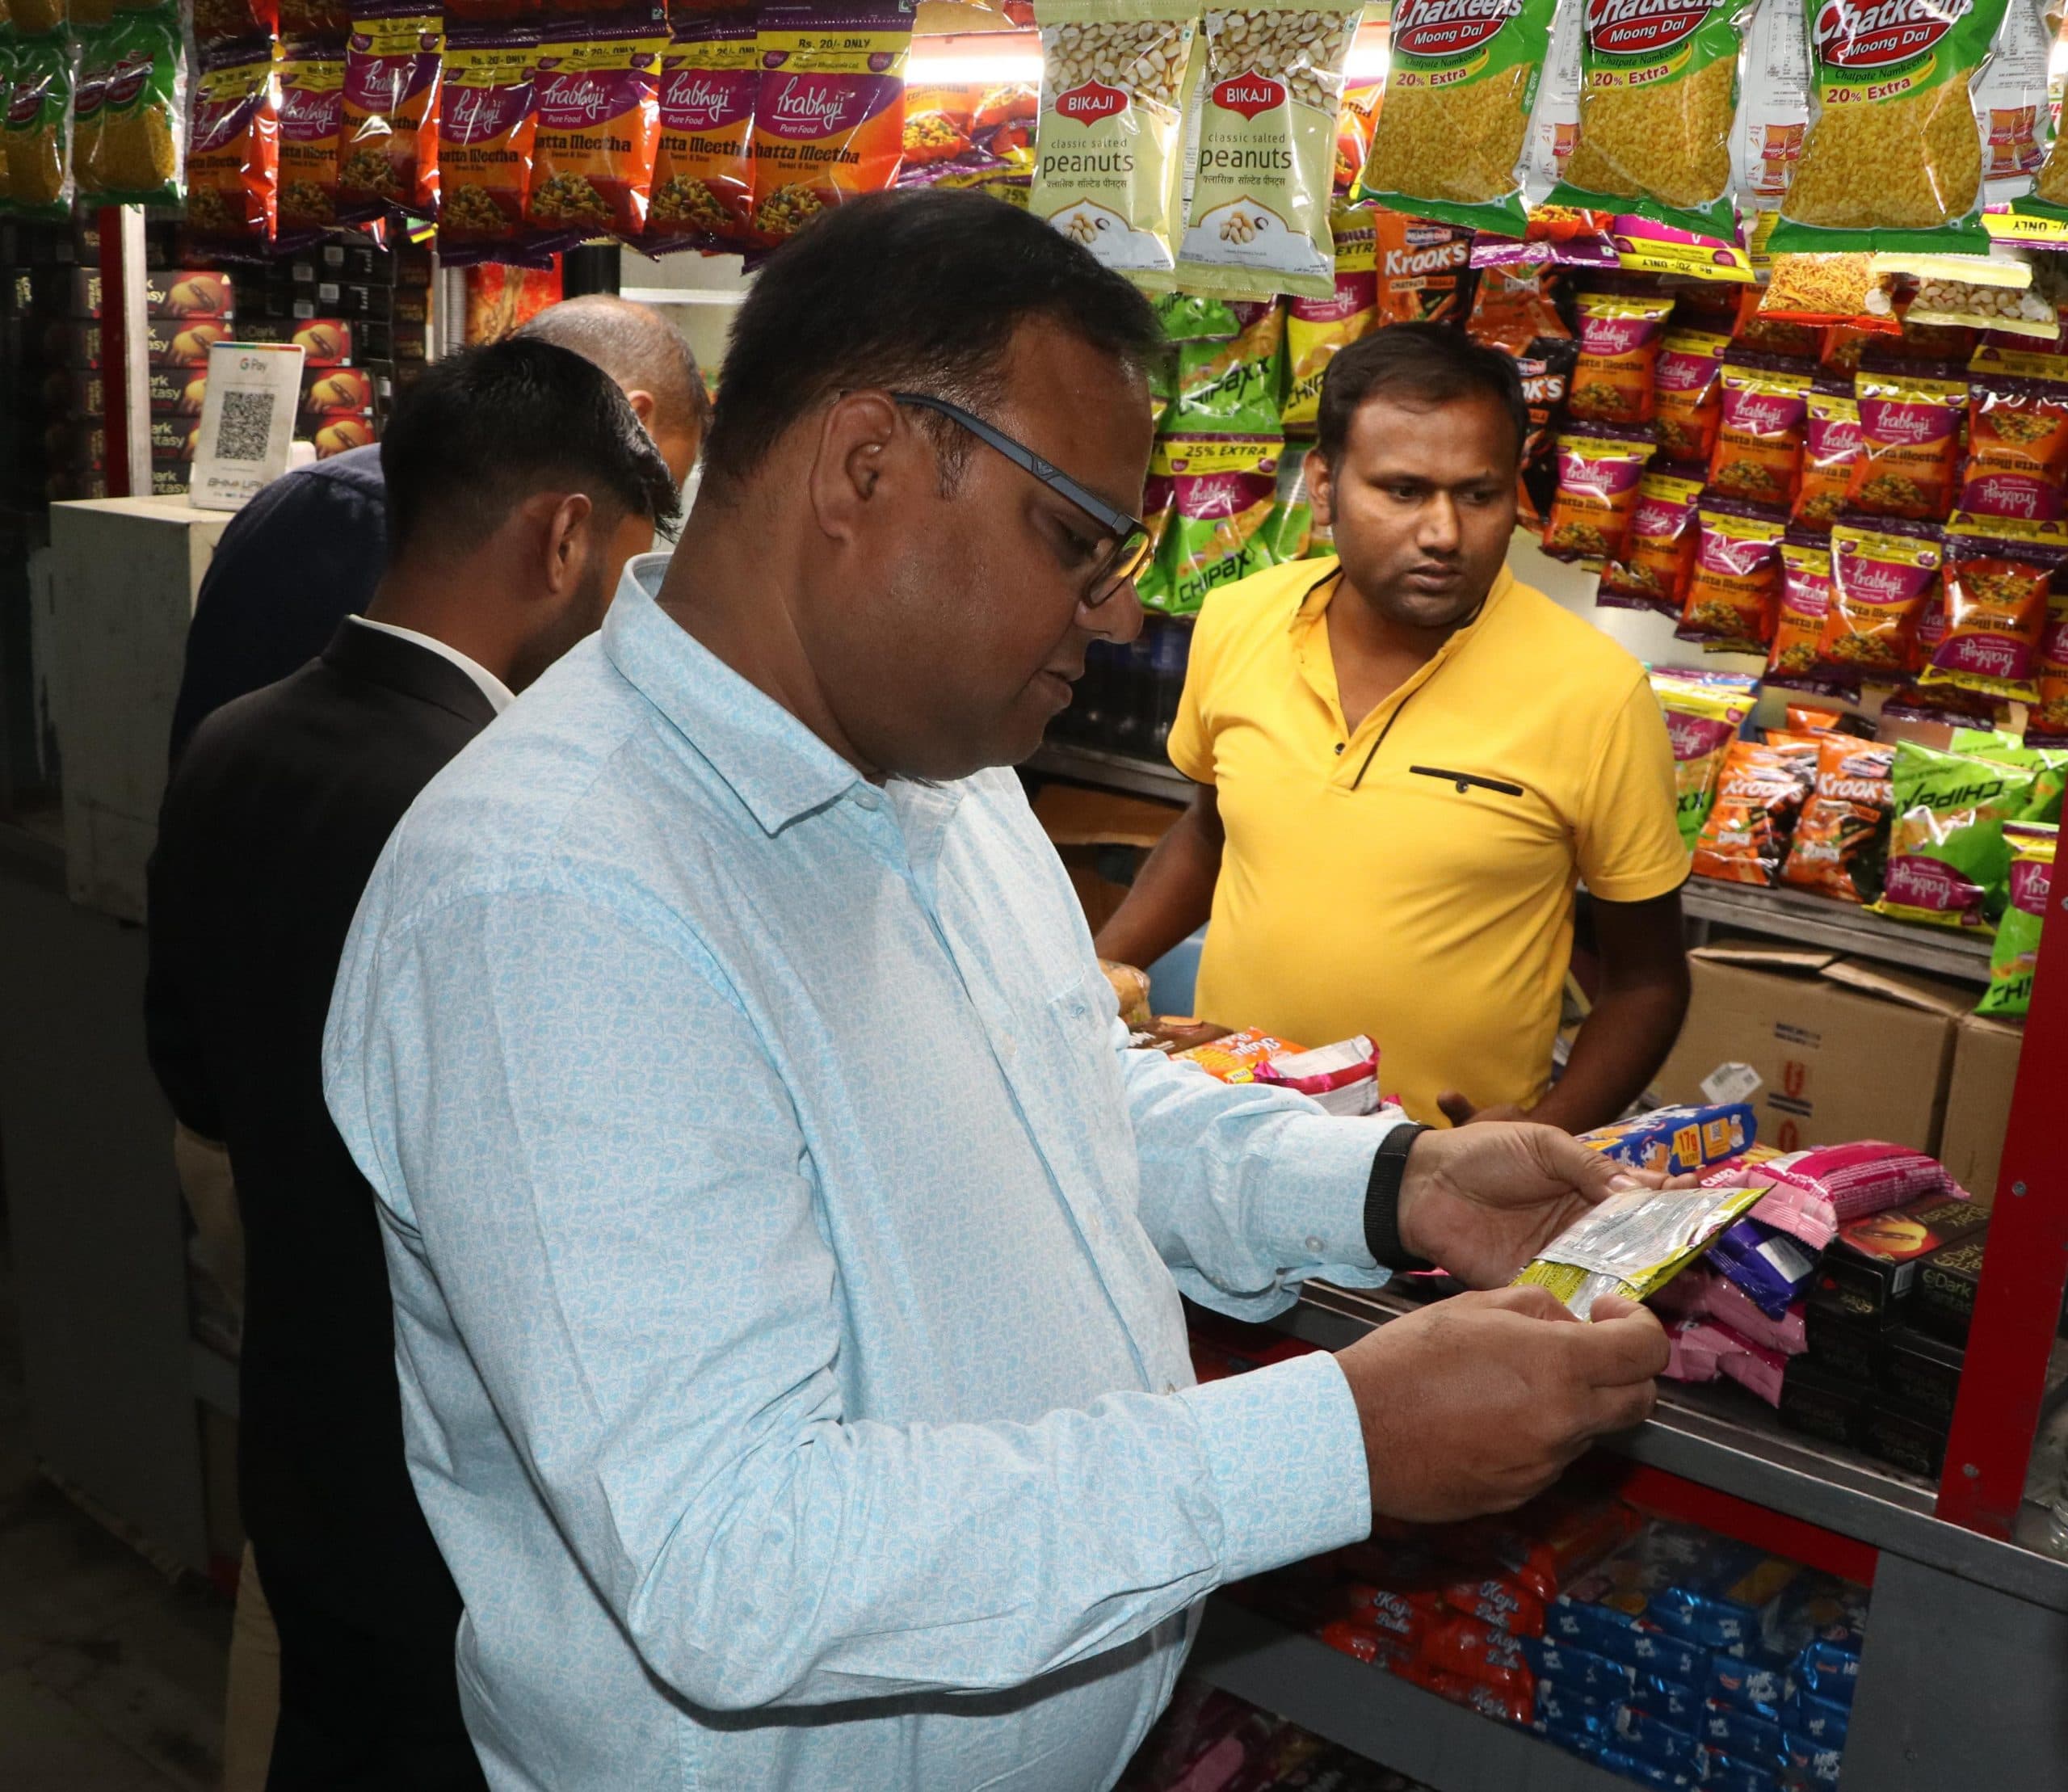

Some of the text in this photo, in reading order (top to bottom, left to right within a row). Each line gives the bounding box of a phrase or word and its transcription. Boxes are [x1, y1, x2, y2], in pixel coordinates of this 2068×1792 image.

[1414, 23, 1484, 45] Moong Dal
[1610, 17, 1686, 43] Moong Dal
[798, 39, 870, 48] Rs. 20/- ONLY
[1846, 27, 1931, 57] Moong Dal
[1396, 69, 1467, 86] 20% Extra
[1593, 65, 1669, 86] 20% Extra
[542, 76, 604, 120] Prabhuji
[664, 72, 730, 122] Prabhuji
[1226, 87, 1271, 103] BIKAJI
[1826, 78, 1911, 103] 20% Extra
[776, 76, 845, 129] Prabhuji
[1068, 95, 1113, 111] BIKAJI
[565, 115, 581, 124] Food
[668, 115, 704, 124] Pure Food
[780, 124, 818, 134] Pure Food
[536, 135, 631, 152] atta Meetha
[1051, 138, 1127, 149] classic salted
[1208, 133, 1285, 143] classic salted
[438, 149, 468, 162] atta
[756, 142, 860, 164] hatta Meetha
[1043, 154, 1134, 179] peanuts
[1200, 149, 1292, 174] peanuts
[2013, 221, 2048, 233] ONLY
[1335, 243, 1377, 256] EXTR
[149, 374, 168, 386] ark
[151, 423, 172, 435] ark
[1185, 446, 1267, 457] 25% EXTRA
[152, 470, 176, 482] ark
[1679, 1130, 1698, 1151] 17g
